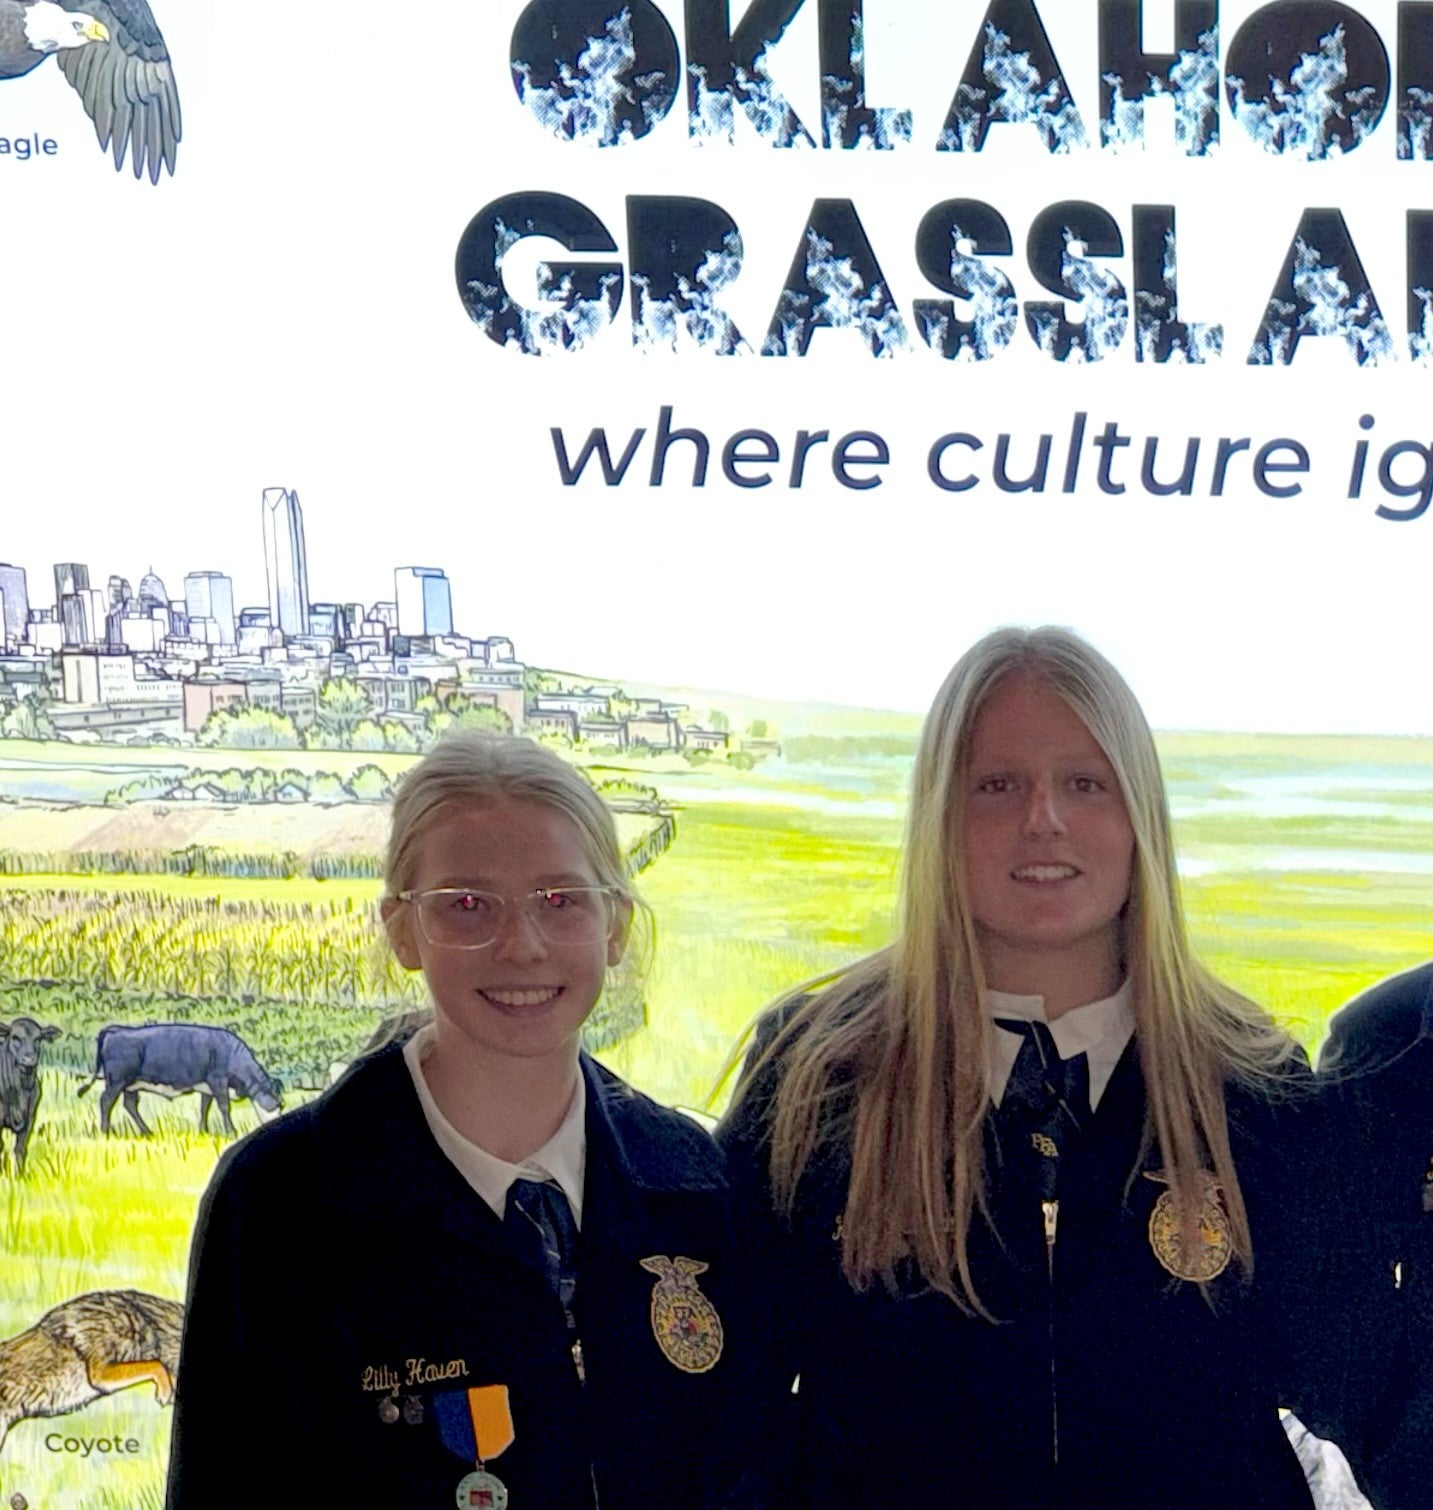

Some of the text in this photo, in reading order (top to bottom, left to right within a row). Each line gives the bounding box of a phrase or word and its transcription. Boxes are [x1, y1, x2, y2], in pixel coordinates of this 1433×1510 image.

[550, 405, 890, 490] where
[927, 411, 1311, 500] culture
[361, 1357, 471, 1398] Lilly Haven
[44, 1432, 140, 1455] Coyote
